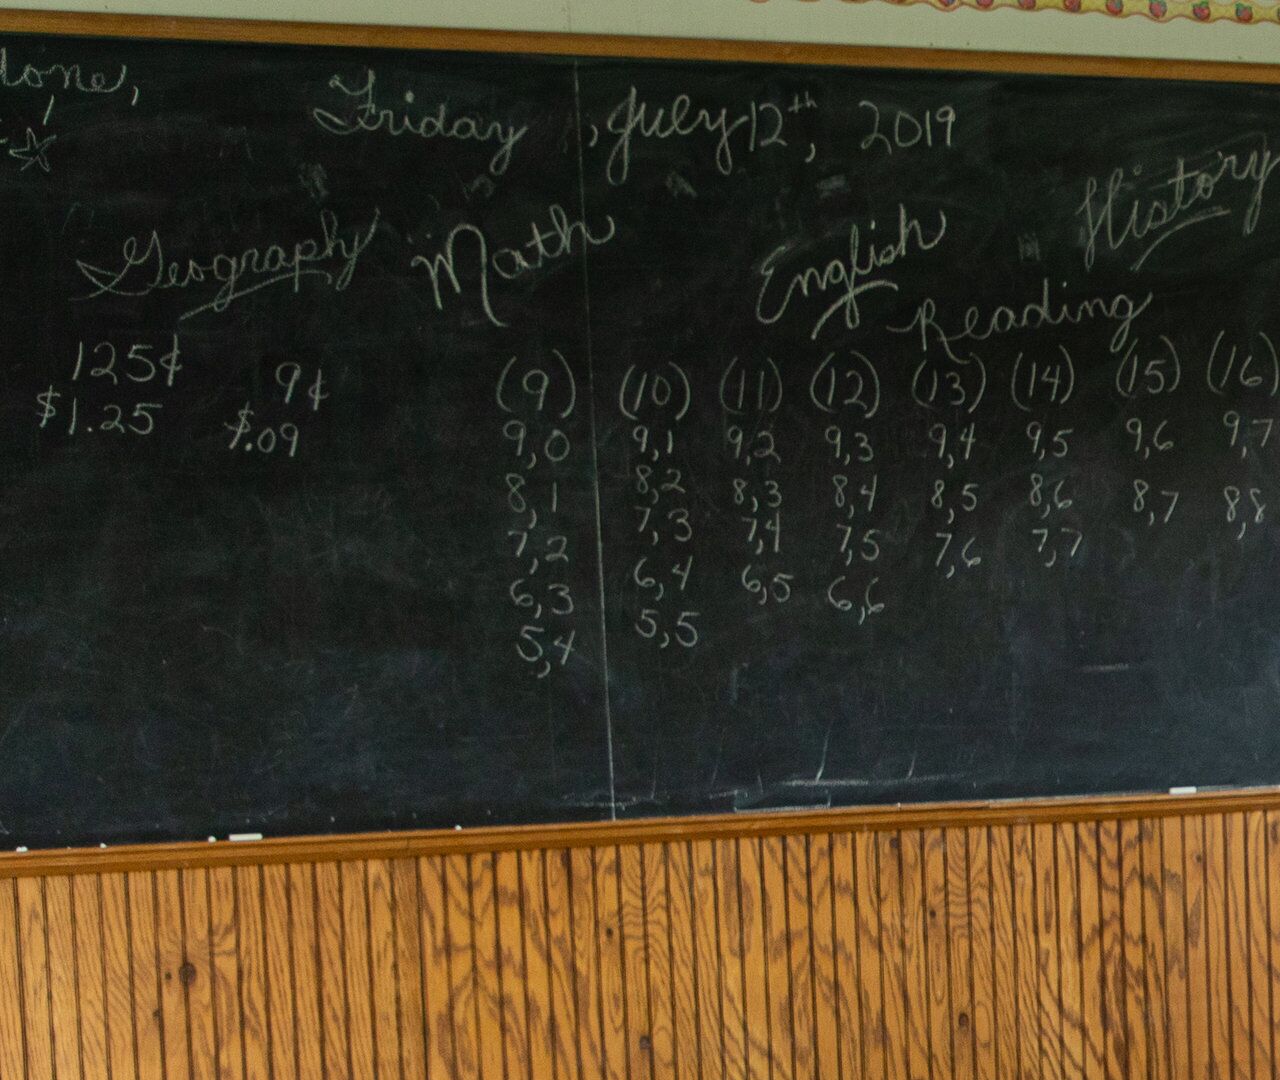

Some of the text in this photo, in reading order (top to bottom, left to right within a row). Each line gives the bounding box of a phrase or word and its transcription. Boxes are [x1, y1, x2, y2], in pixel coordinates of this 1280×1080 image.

[608, 86, 749, 185] July
[859, 100, 957, 153] 2019
[77, 208, 380, 311] Geography
[411, 205, 615, 327] Math
[756, 203, 946, 329] English
[888, 279, 1152, 364] Reading
[36, 385, 163, 436] $1.25
